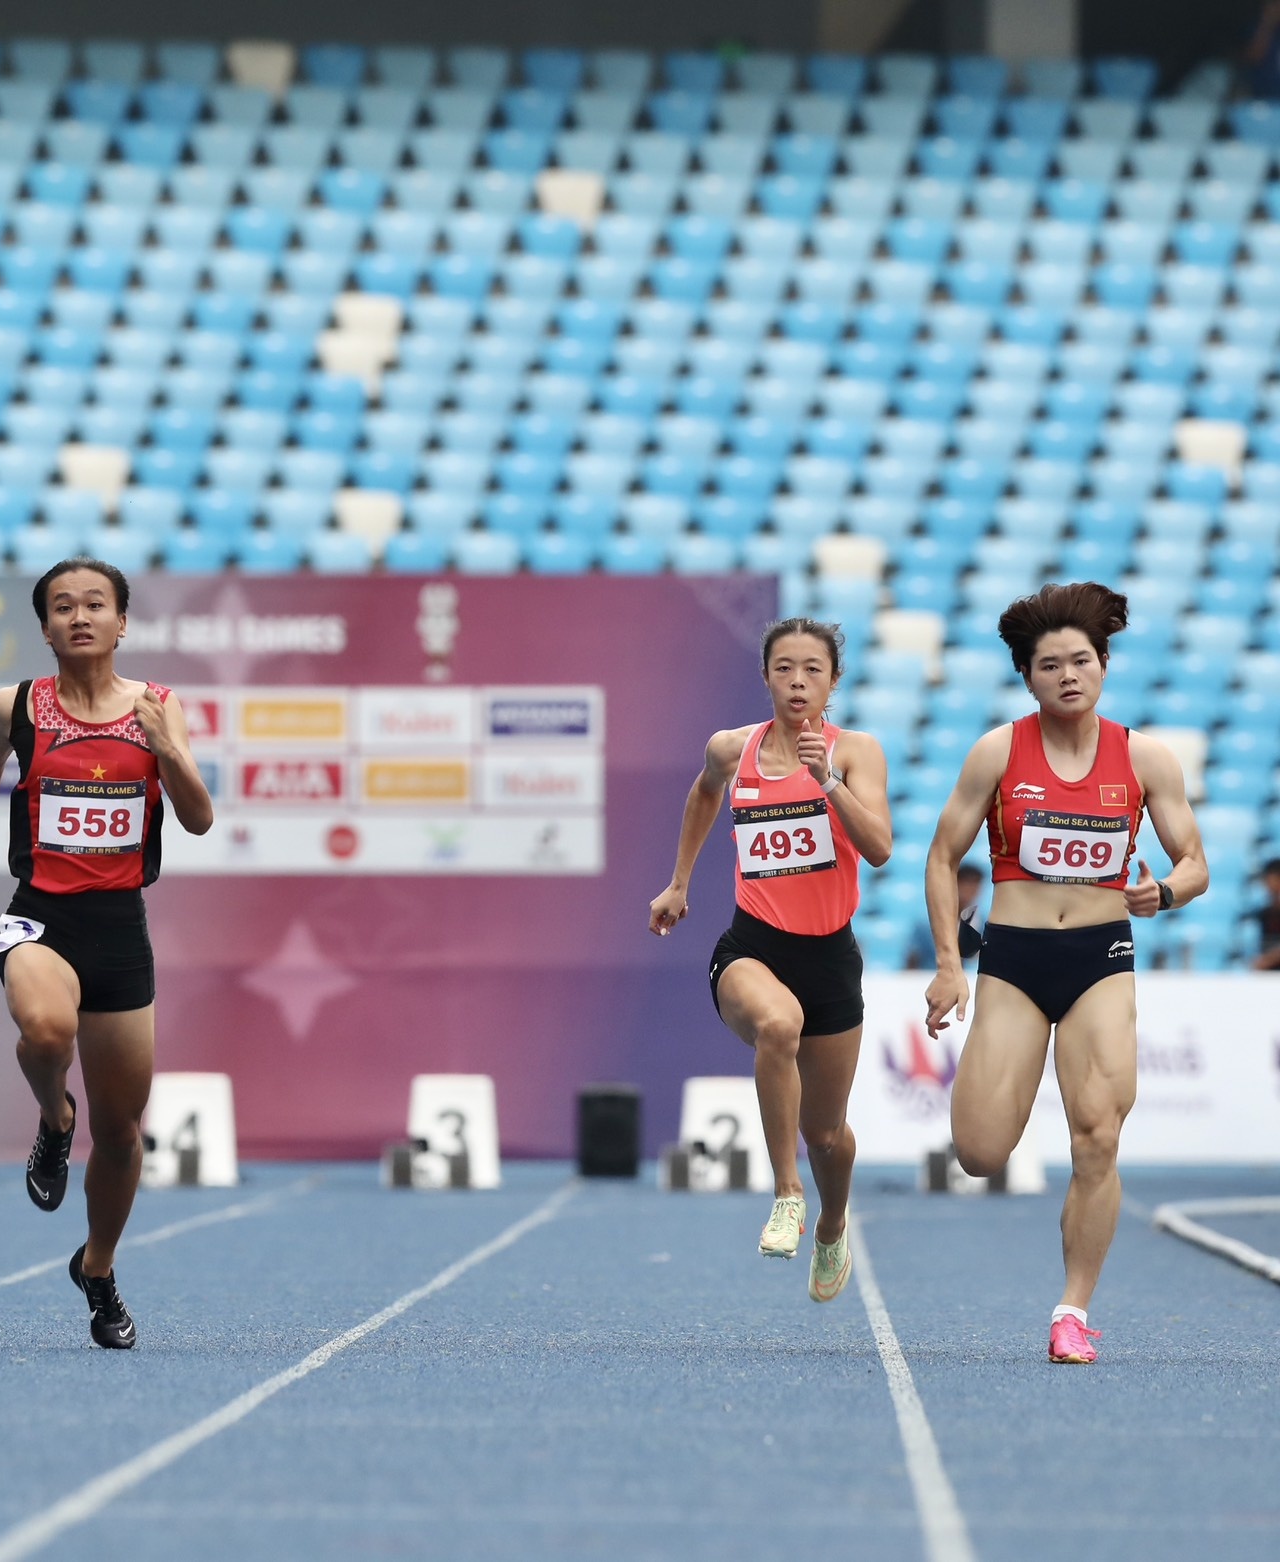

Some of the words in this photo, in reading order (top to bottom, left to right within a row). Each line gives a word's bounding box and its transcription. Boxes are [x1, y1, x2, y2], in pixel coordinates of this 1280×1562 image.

[64, 785, 85, 793] 32nd
[86, 786, 105, 794] SEA
[106, 786, 137, 795] GAMES
[1012, 792, 1046, 801] LI-NING
[57, 806, 131, 837] 558
[749, 810, 768, 819] 32nd
[768, 808, 785, 817] SEA
[785, 804, 815, 815] GAMES
[1048, 816, 1070, 825] 32nd
[1071, 818, 1088, 827] SEA
[1090, 819, 1121, 829] GAMES
[749, 827, 817, 861] 493
[1037, 837, 1113, 869] 569
[173, 1112, 201, 1154] 4
[438, 1110, 467, 1157] 3
[710, 1112, 740, 1160] 2
